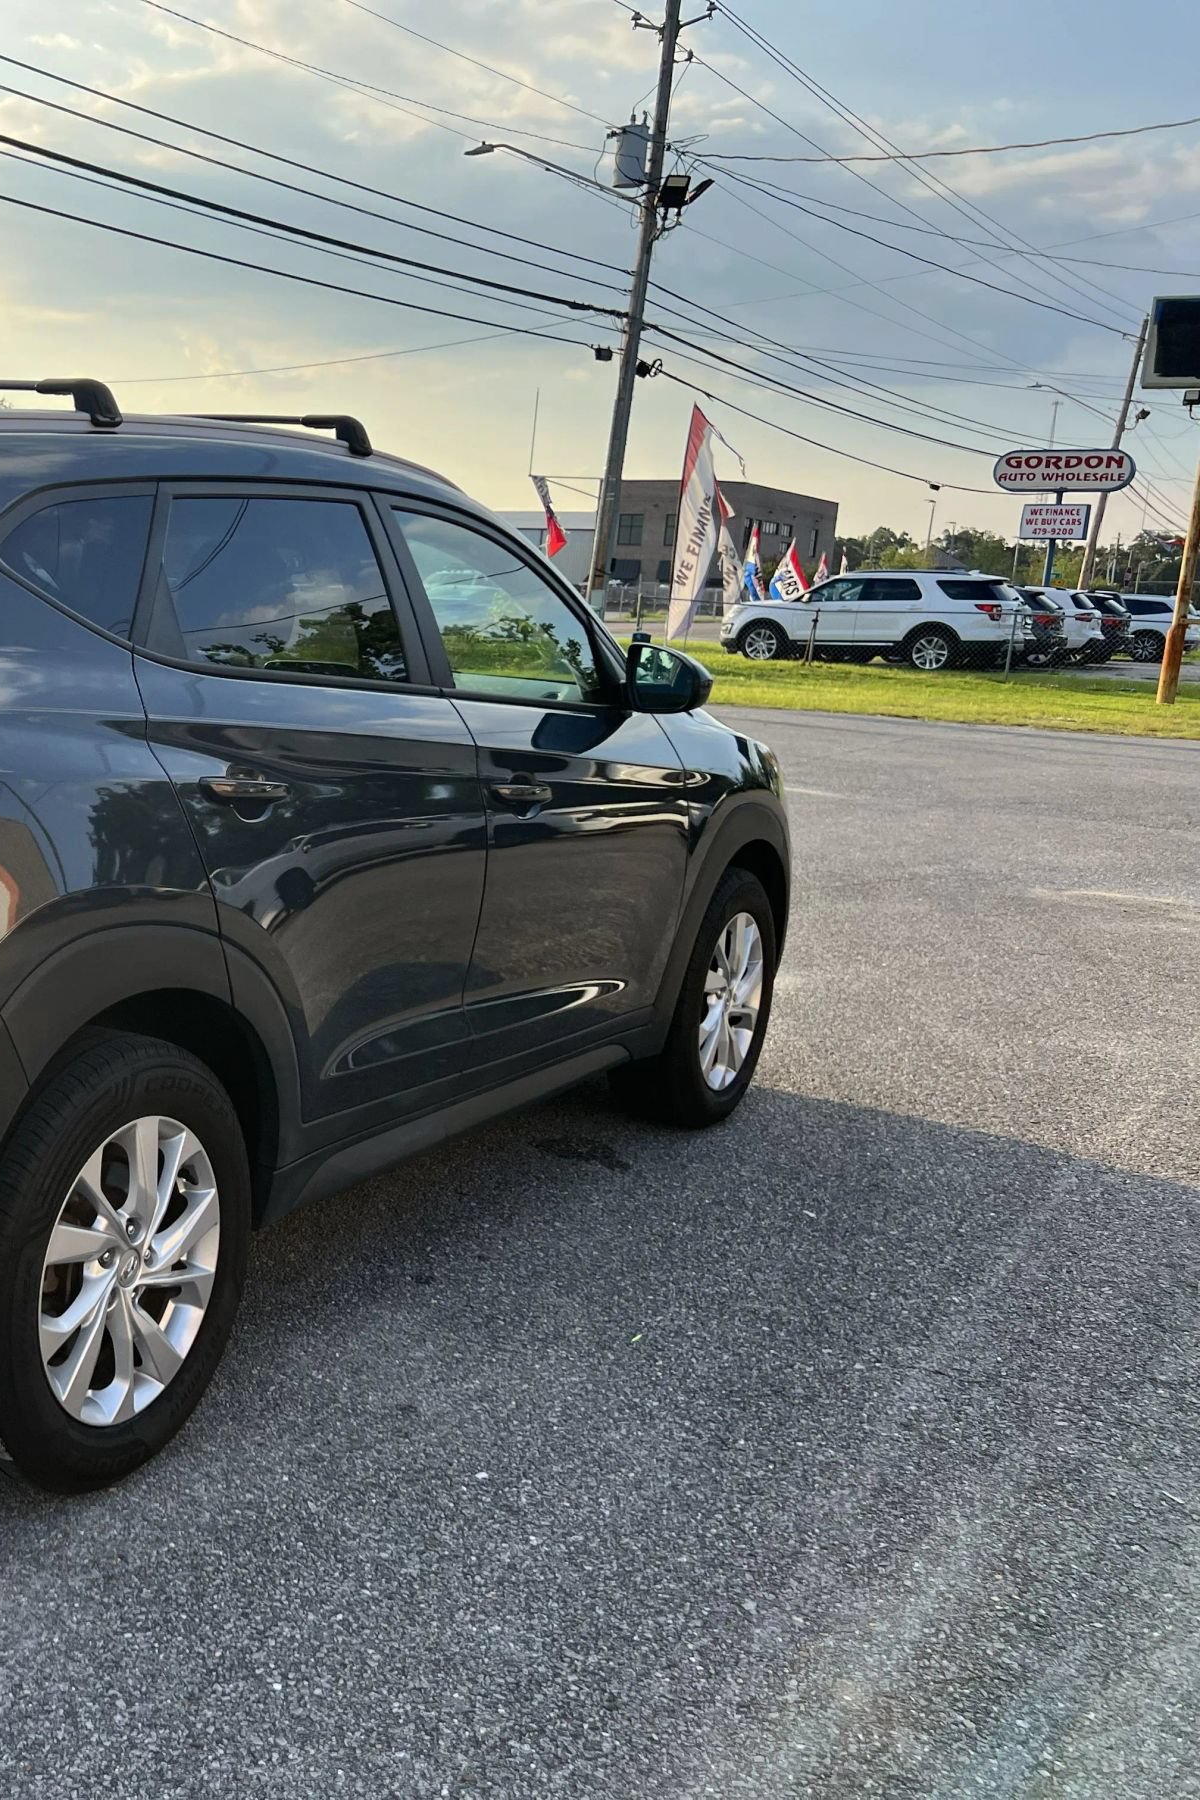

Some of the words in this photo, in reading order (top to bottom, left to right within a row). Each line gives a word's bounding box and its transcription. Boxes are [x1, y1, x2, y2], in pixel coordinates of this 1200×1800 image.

[1005, 455, 1125, 470] GORDON
[998, 472, 1036, 482] AUTO
[1041, 472, 1126, 482] WHOLESALE
[1030, 508, 1043, 516] WE
[1045, 508, 1081, 516] FINANCE
[1025, 518, 1039, 526] WE
[1040, 518, 1058, 526] BUY
[1059, 518, 1082, 526] CARS
[1031, 528, 1074, 536] 479-9200
[674, 560, 694, 587] WE
